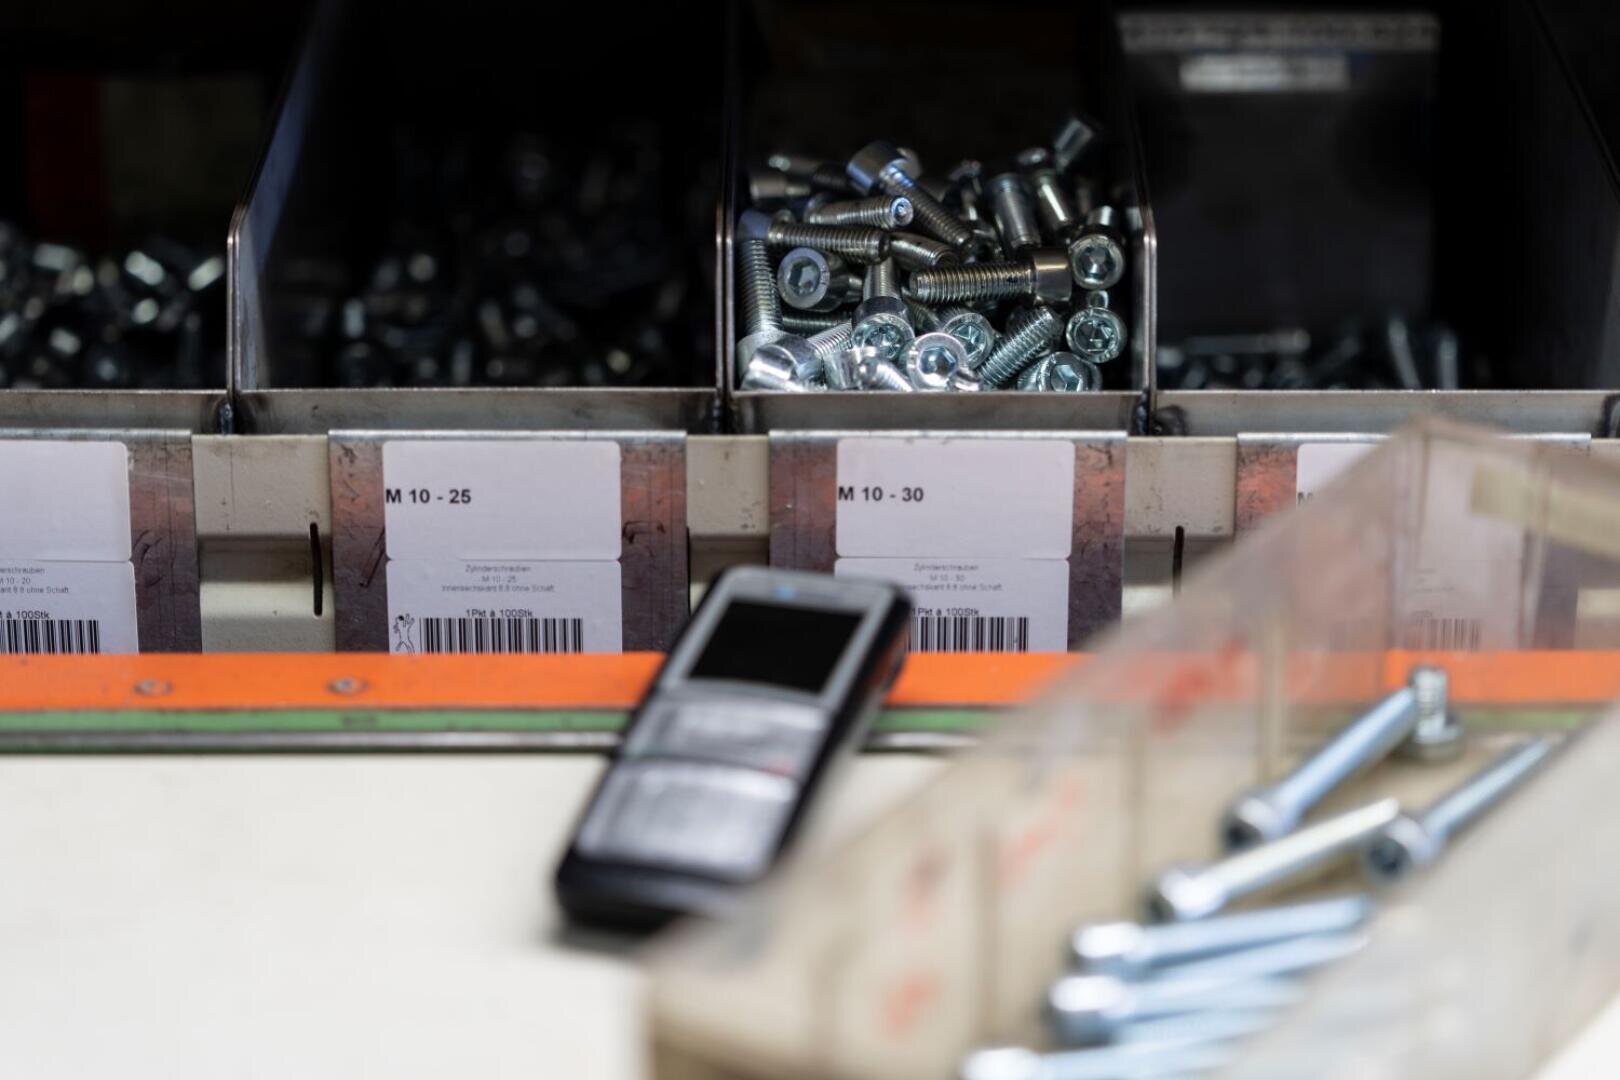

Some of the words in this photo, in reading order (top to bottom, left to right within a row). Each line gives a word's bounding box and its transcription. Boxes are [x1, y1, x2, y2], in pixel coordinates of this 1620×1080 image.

[386, 489, 402, 503] M
[409, 489, 430, 504] 10
[449, 489, 472, 504] 25
[838, 486, 854, 501] M
[862, 487, 883, 502] 10
[902, 487, 924, 502] 30
[16, 610, 50, 619] 100Stk
[466, 608, 486, 617] 1Pkt
[500, 608, 533, 617] 100Stk
[946, 608, 979, 617] 100Stk
